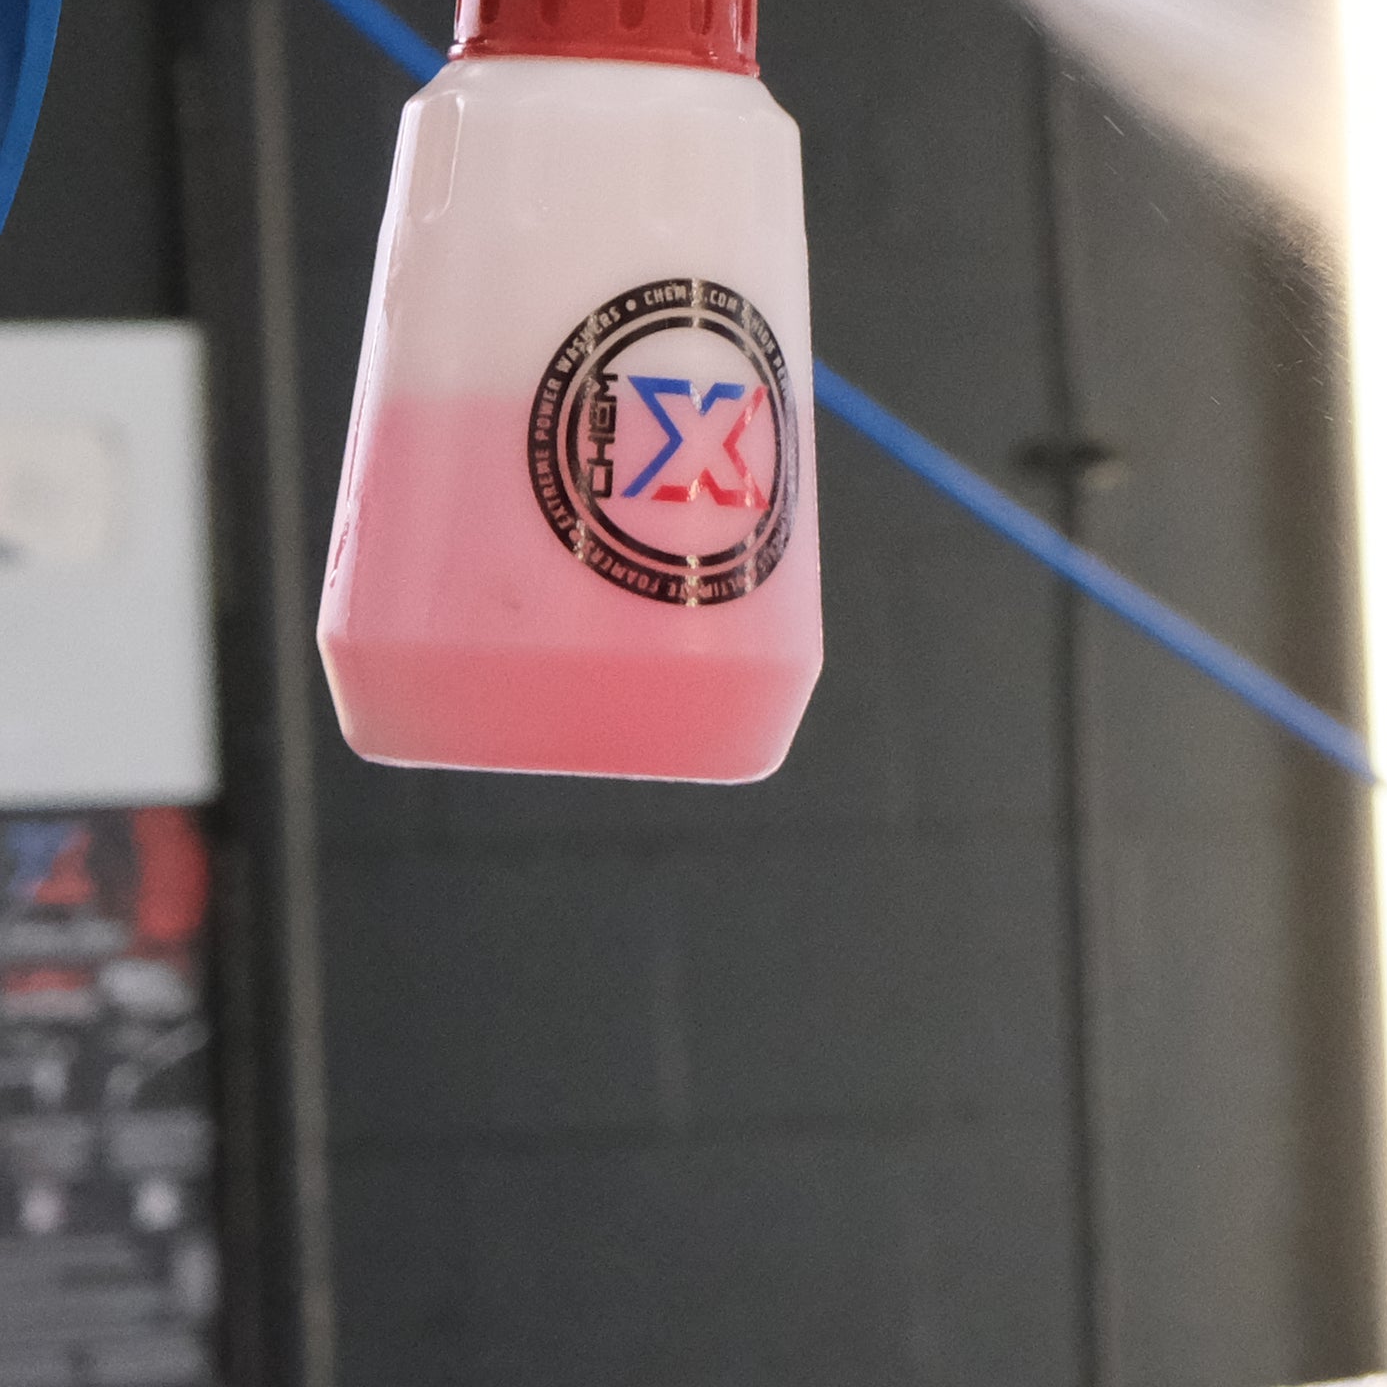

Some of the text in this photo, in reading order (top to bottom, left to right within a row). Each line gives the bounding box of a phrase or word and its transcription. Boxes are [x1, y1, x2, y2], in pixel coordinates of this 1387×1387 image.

[534, 306, 621, 530] EXTREME POWER WASHERS
[587, 372, 619, 500] CHEM
